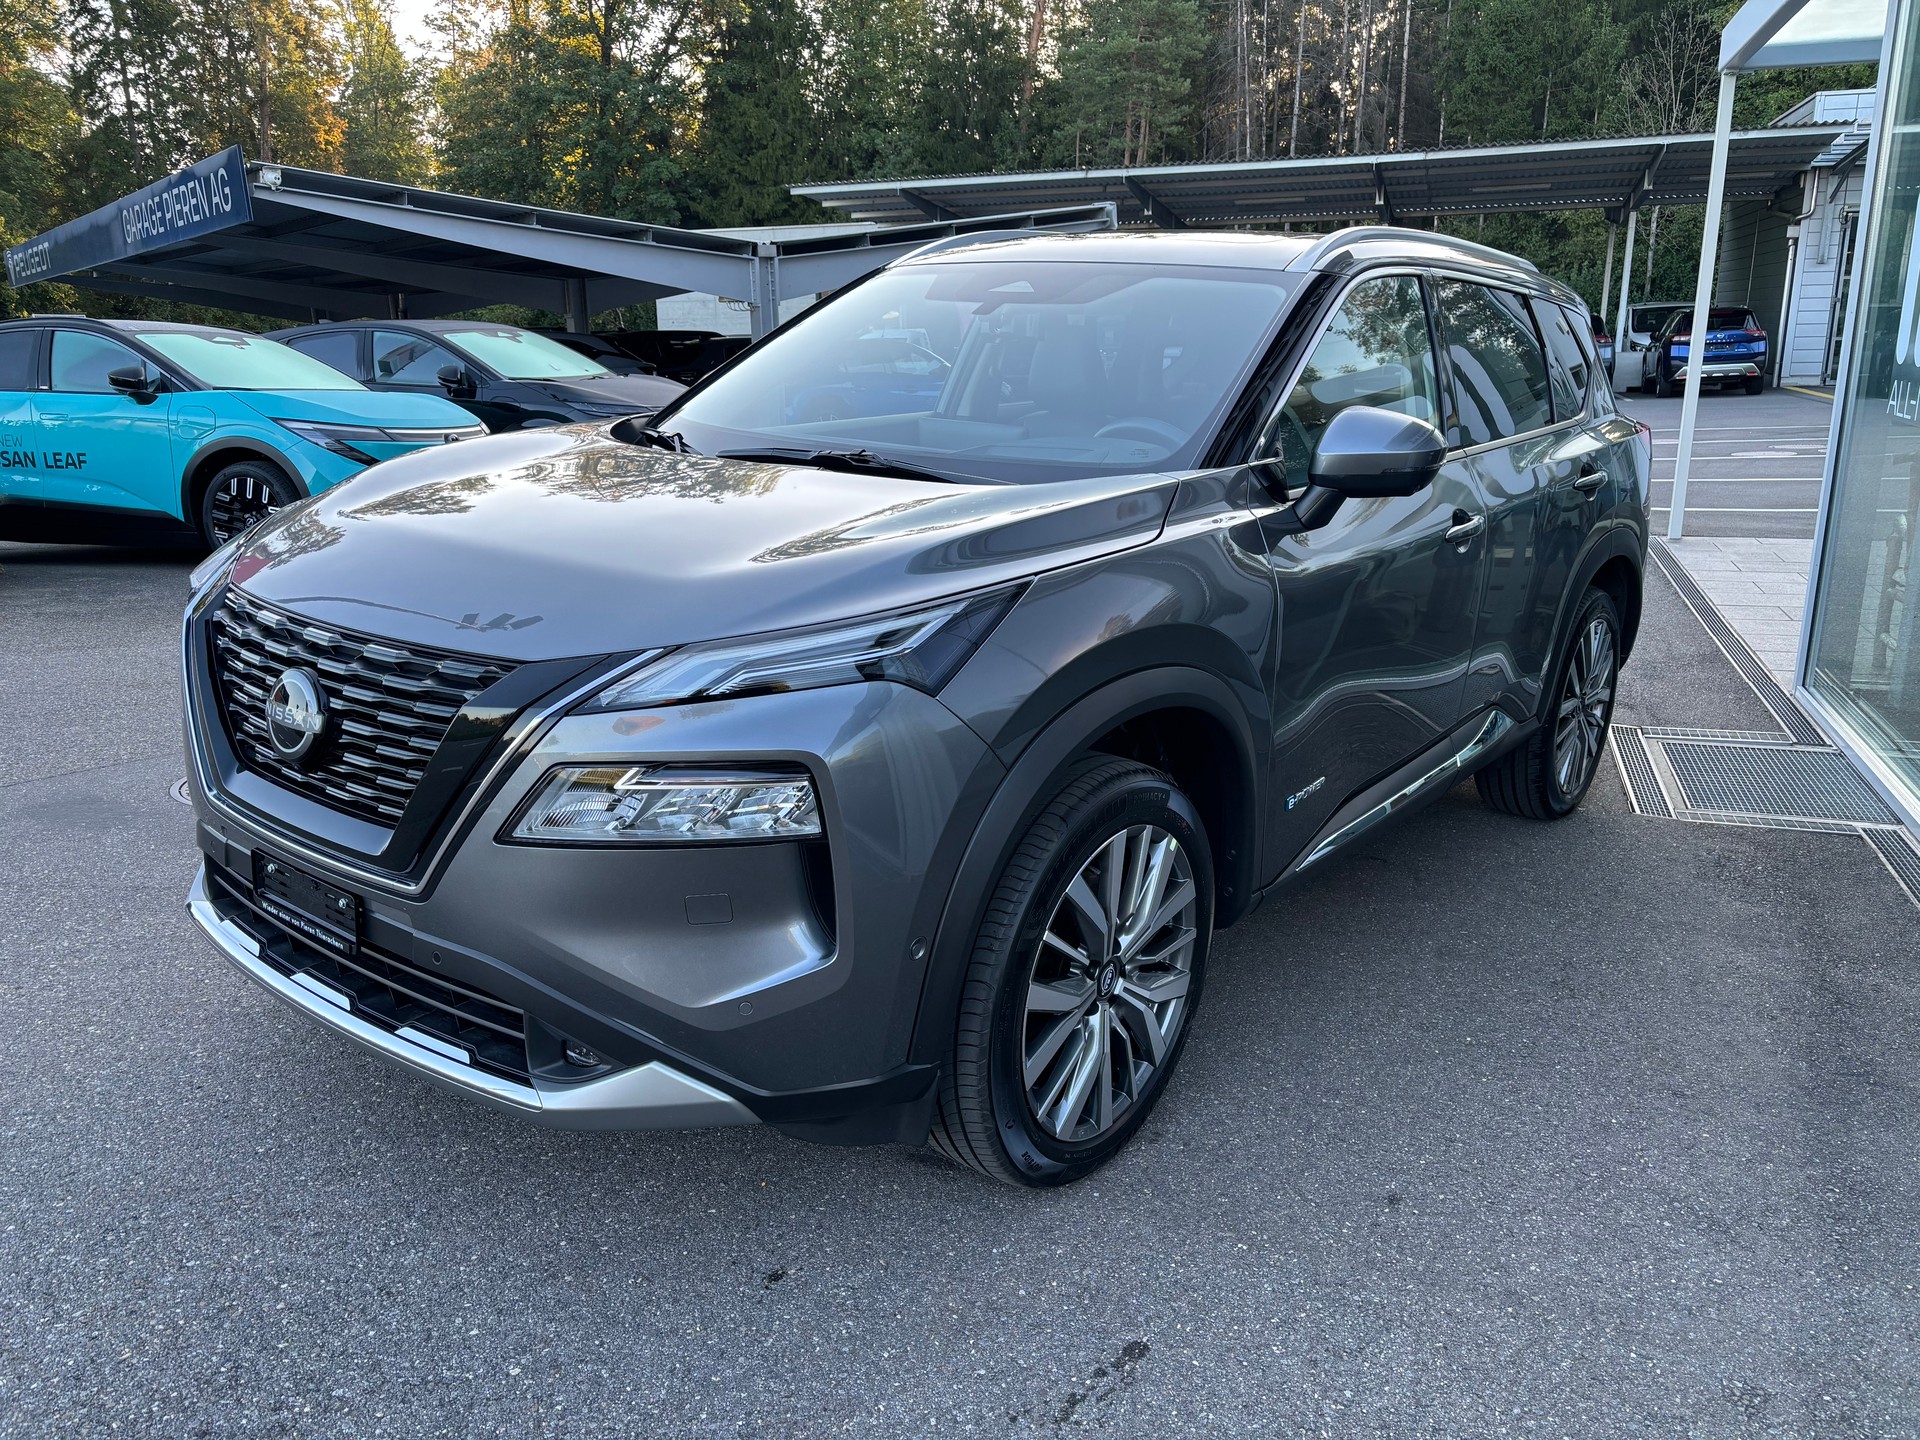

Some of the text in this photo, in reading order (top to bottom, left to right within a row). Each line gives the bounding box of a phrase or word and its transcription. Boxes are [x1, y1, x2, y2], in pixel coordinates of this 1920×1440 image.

[122, 167, 232, 243] GARAGE PIEREN AG
[13, 241, 51, 278] PEUGEOT
[0, 450, 87, 470] SAN LEAF
[265, 699, 320, 731] NISSAN
